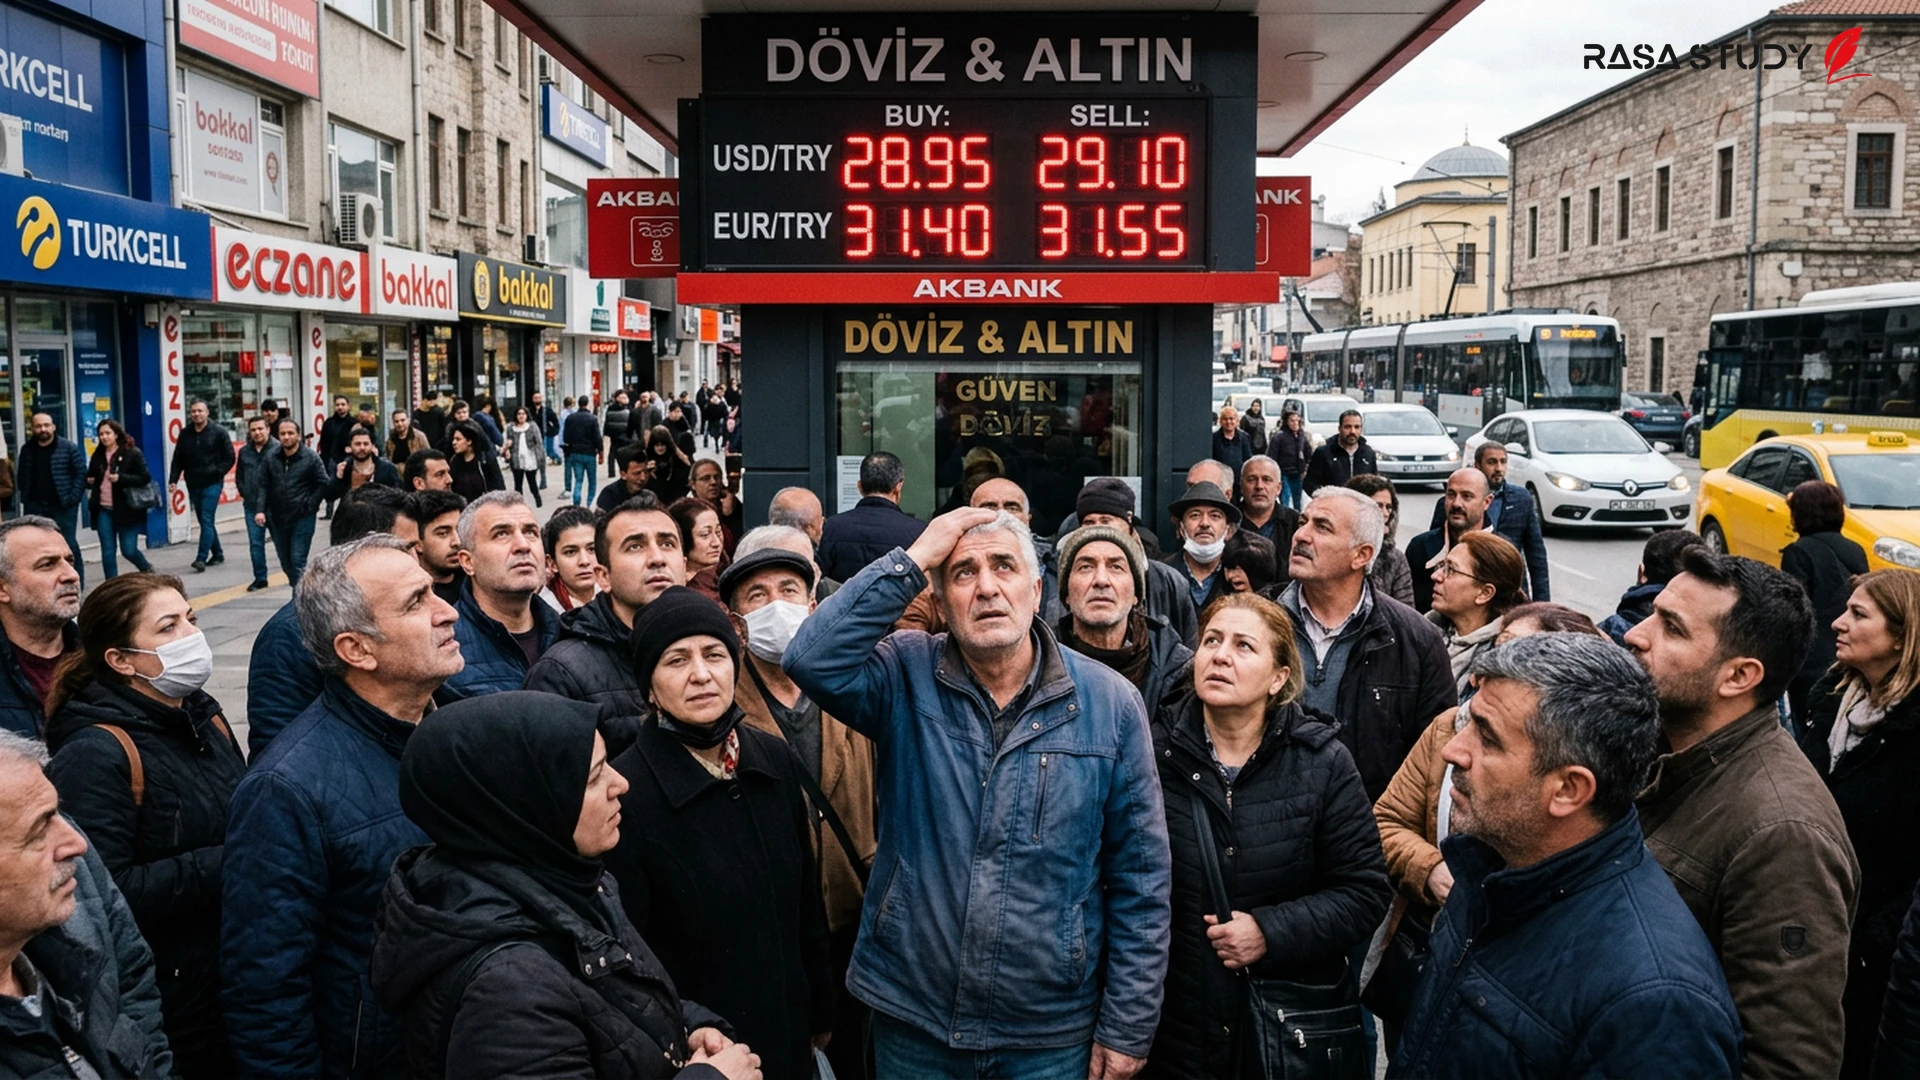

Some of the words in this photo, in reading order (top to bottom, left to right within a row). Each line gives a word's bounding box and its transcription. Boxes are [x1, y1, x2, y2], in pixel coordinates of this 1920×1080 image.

[767, 27, 946, 82] DÖVİZ
[965, 37, 1005, 82] &
[1022, 37, 1192, 82] ALTIN
[195, 100, 253, 145] bakkal
[885, 105, 951, 127] BUY:
[1070, 105, 1150, 127] SELL:
[713, 143, 832, 173] USD/TRY
[841, 134, 992, 191] 28.95
[1036, 134, 1188, 191] 29.10
[596, 191, 680, 207] AKBA
[67, 218, 187, 270] TURKCELL
[713, 211, 832, 240] EUR/TRY
[846, 203, 992, 259] 31.40
[1041, 203, 1187, 259] 31.55
[226, 241, 358, 300] eczane
[381, 257, 453, 310] bakkal
[498, 265, 554, 310] bakkal
[913, 278, 1063, 298] AKBANK
[845, 312, 964, 354] DÖVİZ
[977, 319, 1005, 354] &
[1018, 319, 1134, 354] ALTIN
[956, 375, 1057, 402] GÜVEN
